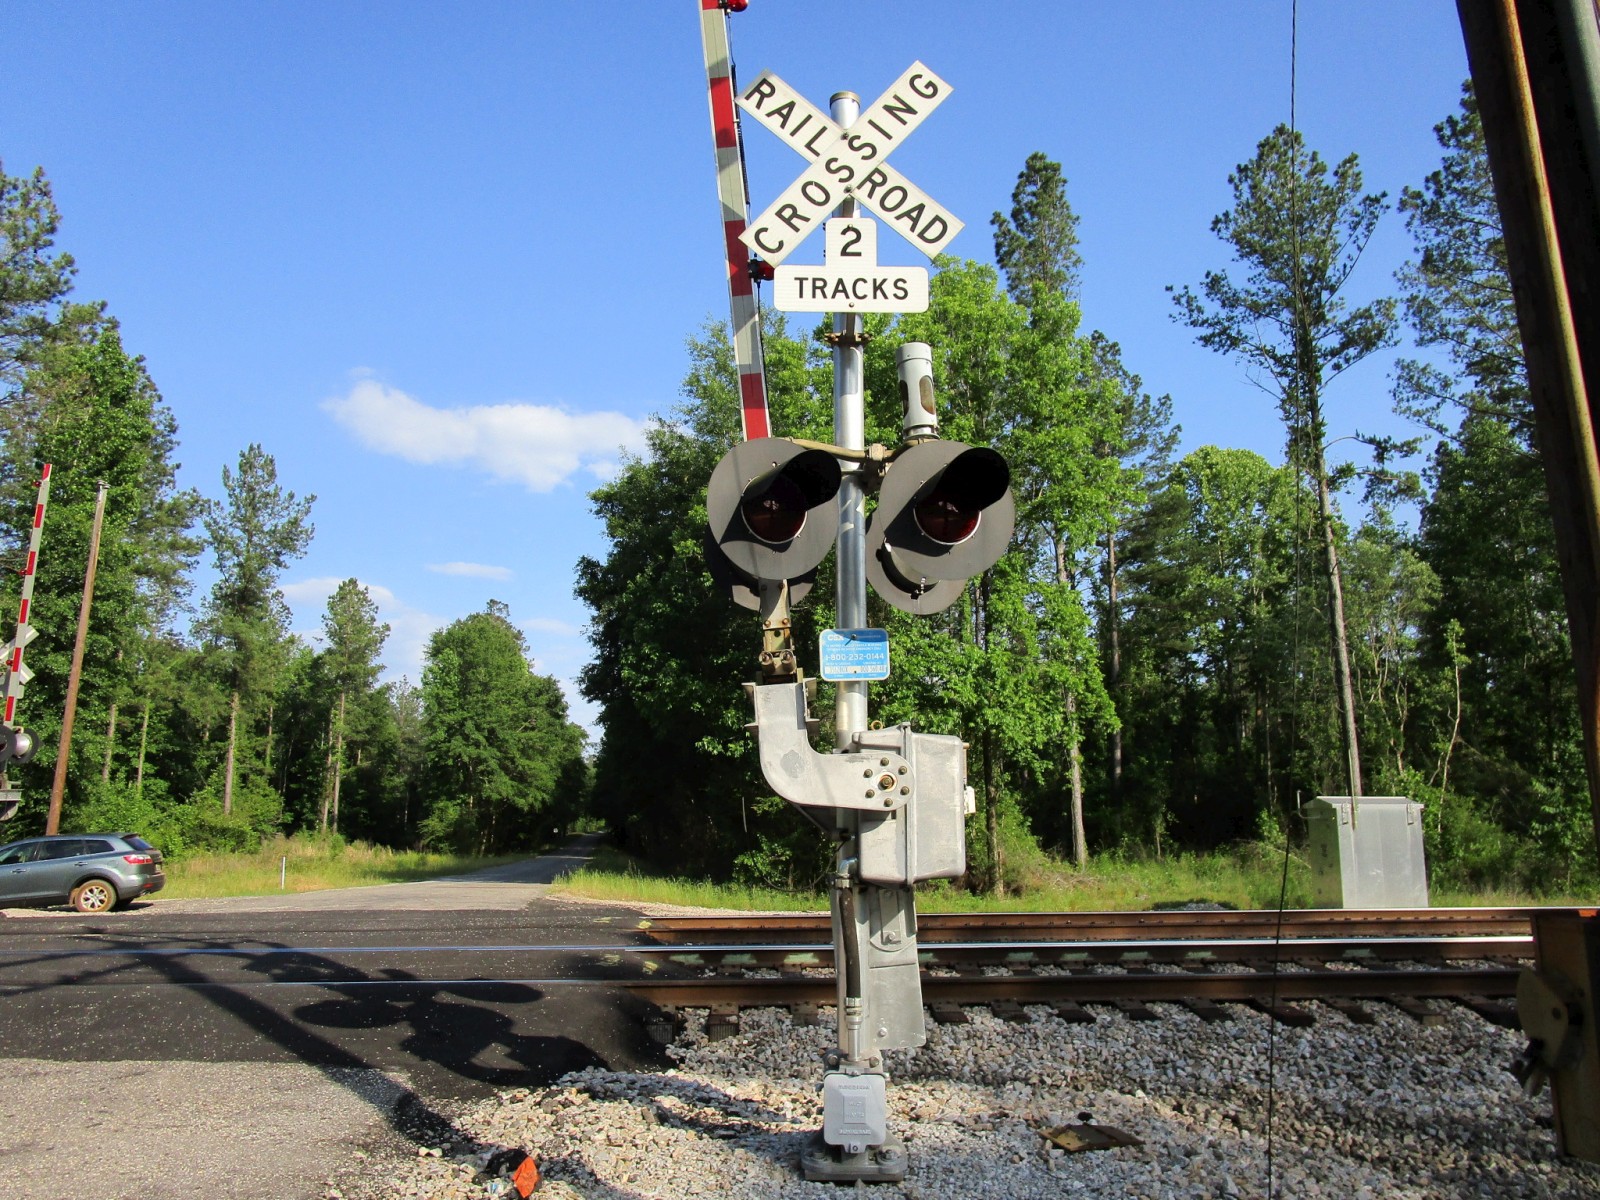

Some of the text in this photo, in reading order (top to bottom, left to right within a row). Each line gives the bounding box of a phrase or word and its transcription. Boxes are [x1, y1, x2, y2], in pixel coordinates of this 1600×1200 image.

[744, 77, 948, 244] RAIL ROAD
[754, 73, 939, 254] CROSSING
[794, 276, 909, 301] TRACKS
[840, 226, 862, 257] 2
